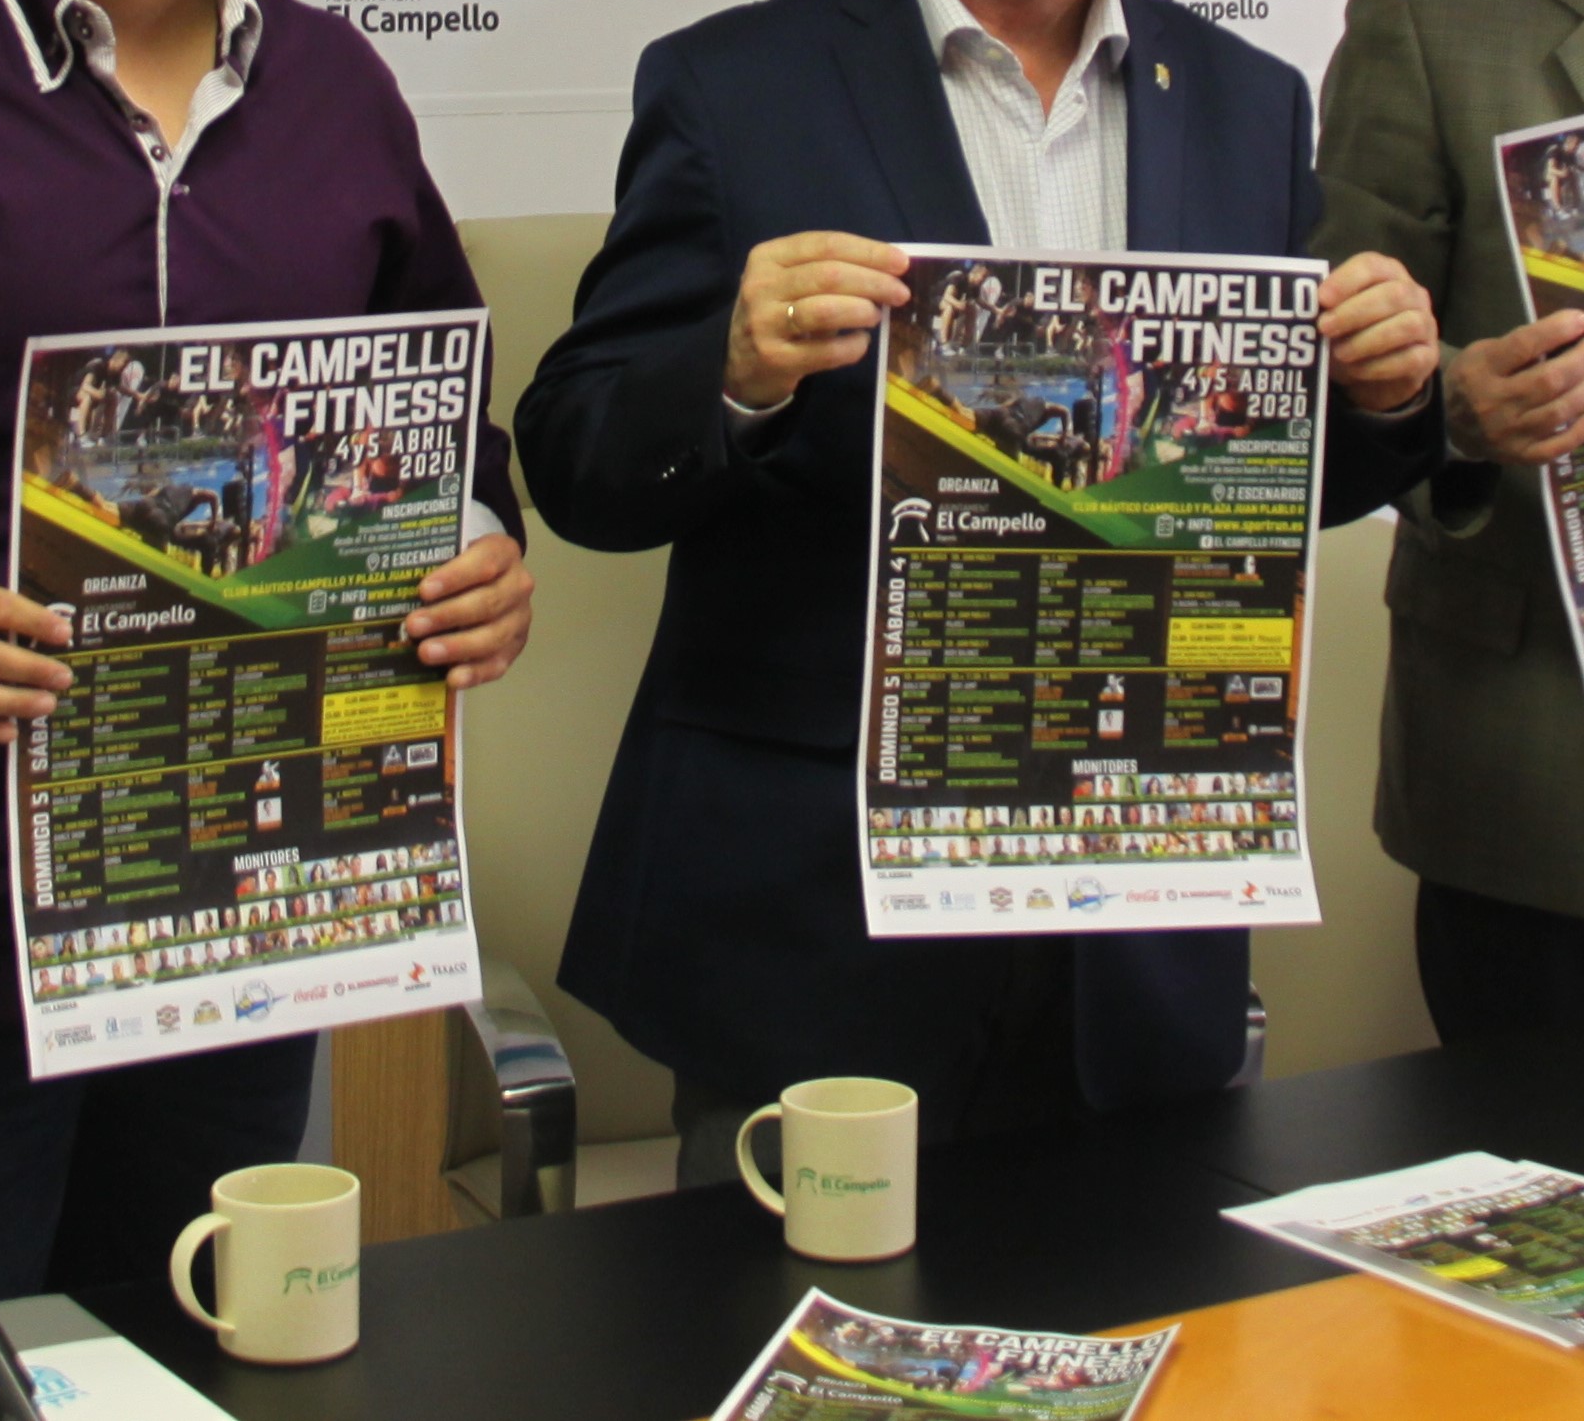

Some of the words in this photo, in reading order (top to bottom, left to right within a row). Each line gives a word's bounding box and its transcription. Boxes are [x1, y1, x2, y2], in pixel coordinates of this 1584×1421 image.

[361, 4, 499, 40] Campello
[1033, 268, 1085, 311] EL
[1100, 270, 1318, 319] CAMPELLO
[1132, 319, 1315, 367] FITNESS
[179, 346, 234, 392] EL
[251, 328, 470, 388] CAMPELLO
[1238, 369, 1307, 394] ABRIL
[284, 377, 465, 437] FITNESS
[1247, 394, 1308, 418] 2020
[391, 425, 456, 456] ABRIL
[1228, 440, 1309, 455] INSCRIPCIONES
[399, 450, 456, 479] 2020
[938, 477, 999, 493] ORGANIZA
[1226, 488, 1237, 500] 2
[1238, 487, 1305, 501] ESCENARIOS
[383, 499, 457, 521] INSCRIPCIONES
[937, 511, 953, 530] El
[959, 511, 1046, 535] Campello
[1187, 518, 1213, 532] INFO
[380, 552, 391, 568] 2
[393, 545, 456, 566] ESCENARIOS
[889, 556, 906, 572] 4
[84, 574, 147, 594] ORGANIZA
[296, 576, 346, 591] CAMPELLO
[356, 572, 386, 585] PLAZA
[342, 589, 367, 604] INFO
[83, 610, 100, 633] El
[105, 604, 196, 632] Campello
[884, 578, 905, 656] SÁBADO
[885, 675, 901, 688] 5
[880, 695, 900, 782] DOMINGO
[1072, 759, 1138, 775] MONITORES
[33, 791, 49, 806] 5
[33, 812, 54, 907] DOMINGO
[234, 846, 300, 872] MONITORES
[921, 1330, 962, 1345] EL
[975, 1332, 1163, 1357] CAMPELLO
[996, 1347, 1159, 1372] FITNESS
